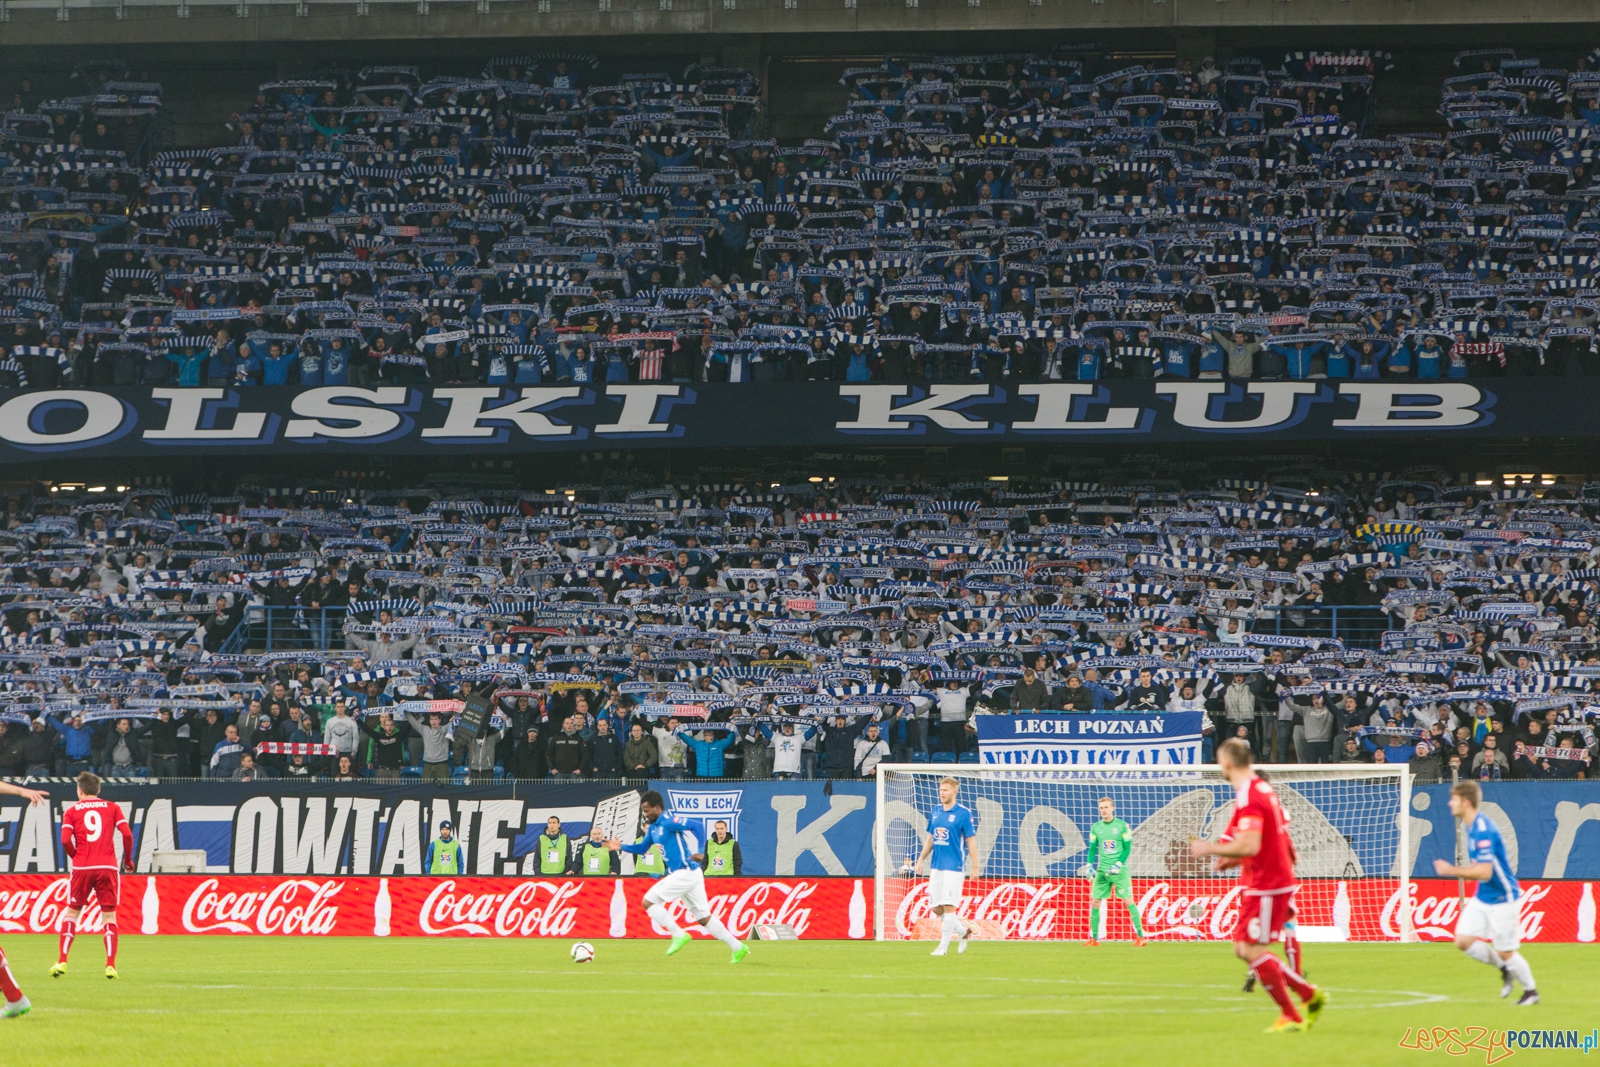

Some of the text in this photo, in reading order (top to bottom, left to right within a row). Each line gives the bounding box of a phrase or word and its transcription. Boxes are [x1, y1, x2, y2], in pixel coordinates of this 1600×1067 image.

[617, 113, 642, 122] ECH
[1093, 298, 1118, 306] ECH
[1309, 301, 1331, 310] ECH
[324, 311, 348, 319] ECH
[1549, 327, 1566, 336] CH
[475, 337, 514, 346] OLEJOR
[1168, 355, 1184, 363] 2015
[835, 383, 1488, 433] KLUB
[1006, 491, 1058, 500] KUJAWIACY
[554, 528, 608, 538] KOLE JORZ
[1522, 537, 1592, 551] DESPE RADOS
[537, 611, 556, 619] LECH
[65, 621, 113, 632] Lech 1922
[354, 625, 407, 634] FORZA LECH
[466, 637, 486, 645] LECH
[1253, 635, 1308, 648] SZAMOTUŁY
[1198, 648, 1252, 658] SZAMOTUŁY
[1310, 649, 1366, 660] TYLKO LECH
[476, 663, 522, 673] ECH POZ
[528, 672, 555, 681] ECH
[934, 670, 978, 680] JAROCIN
[776, 694, 831, 705] ECH POZ
[469, 703, 483, 712] LECH
[710, 702, 734, 711] TYLKO
[461, 721, 478, 733] WIARA
[1014, 716, 1165, 734] LECH POZNAŃ
[1525, 746, 1580, 760] SALVATOR
[75, 801, 108, 811] BOGUSKI
[677, 797, 732, 808] KKS LECH
[83, 810, 103, 842] 9
[1102, 840, 1116, 850] STS
[182, 877, 345, 935] Coca-Cola
[419, 880, 584, 936] Coca-Cola
